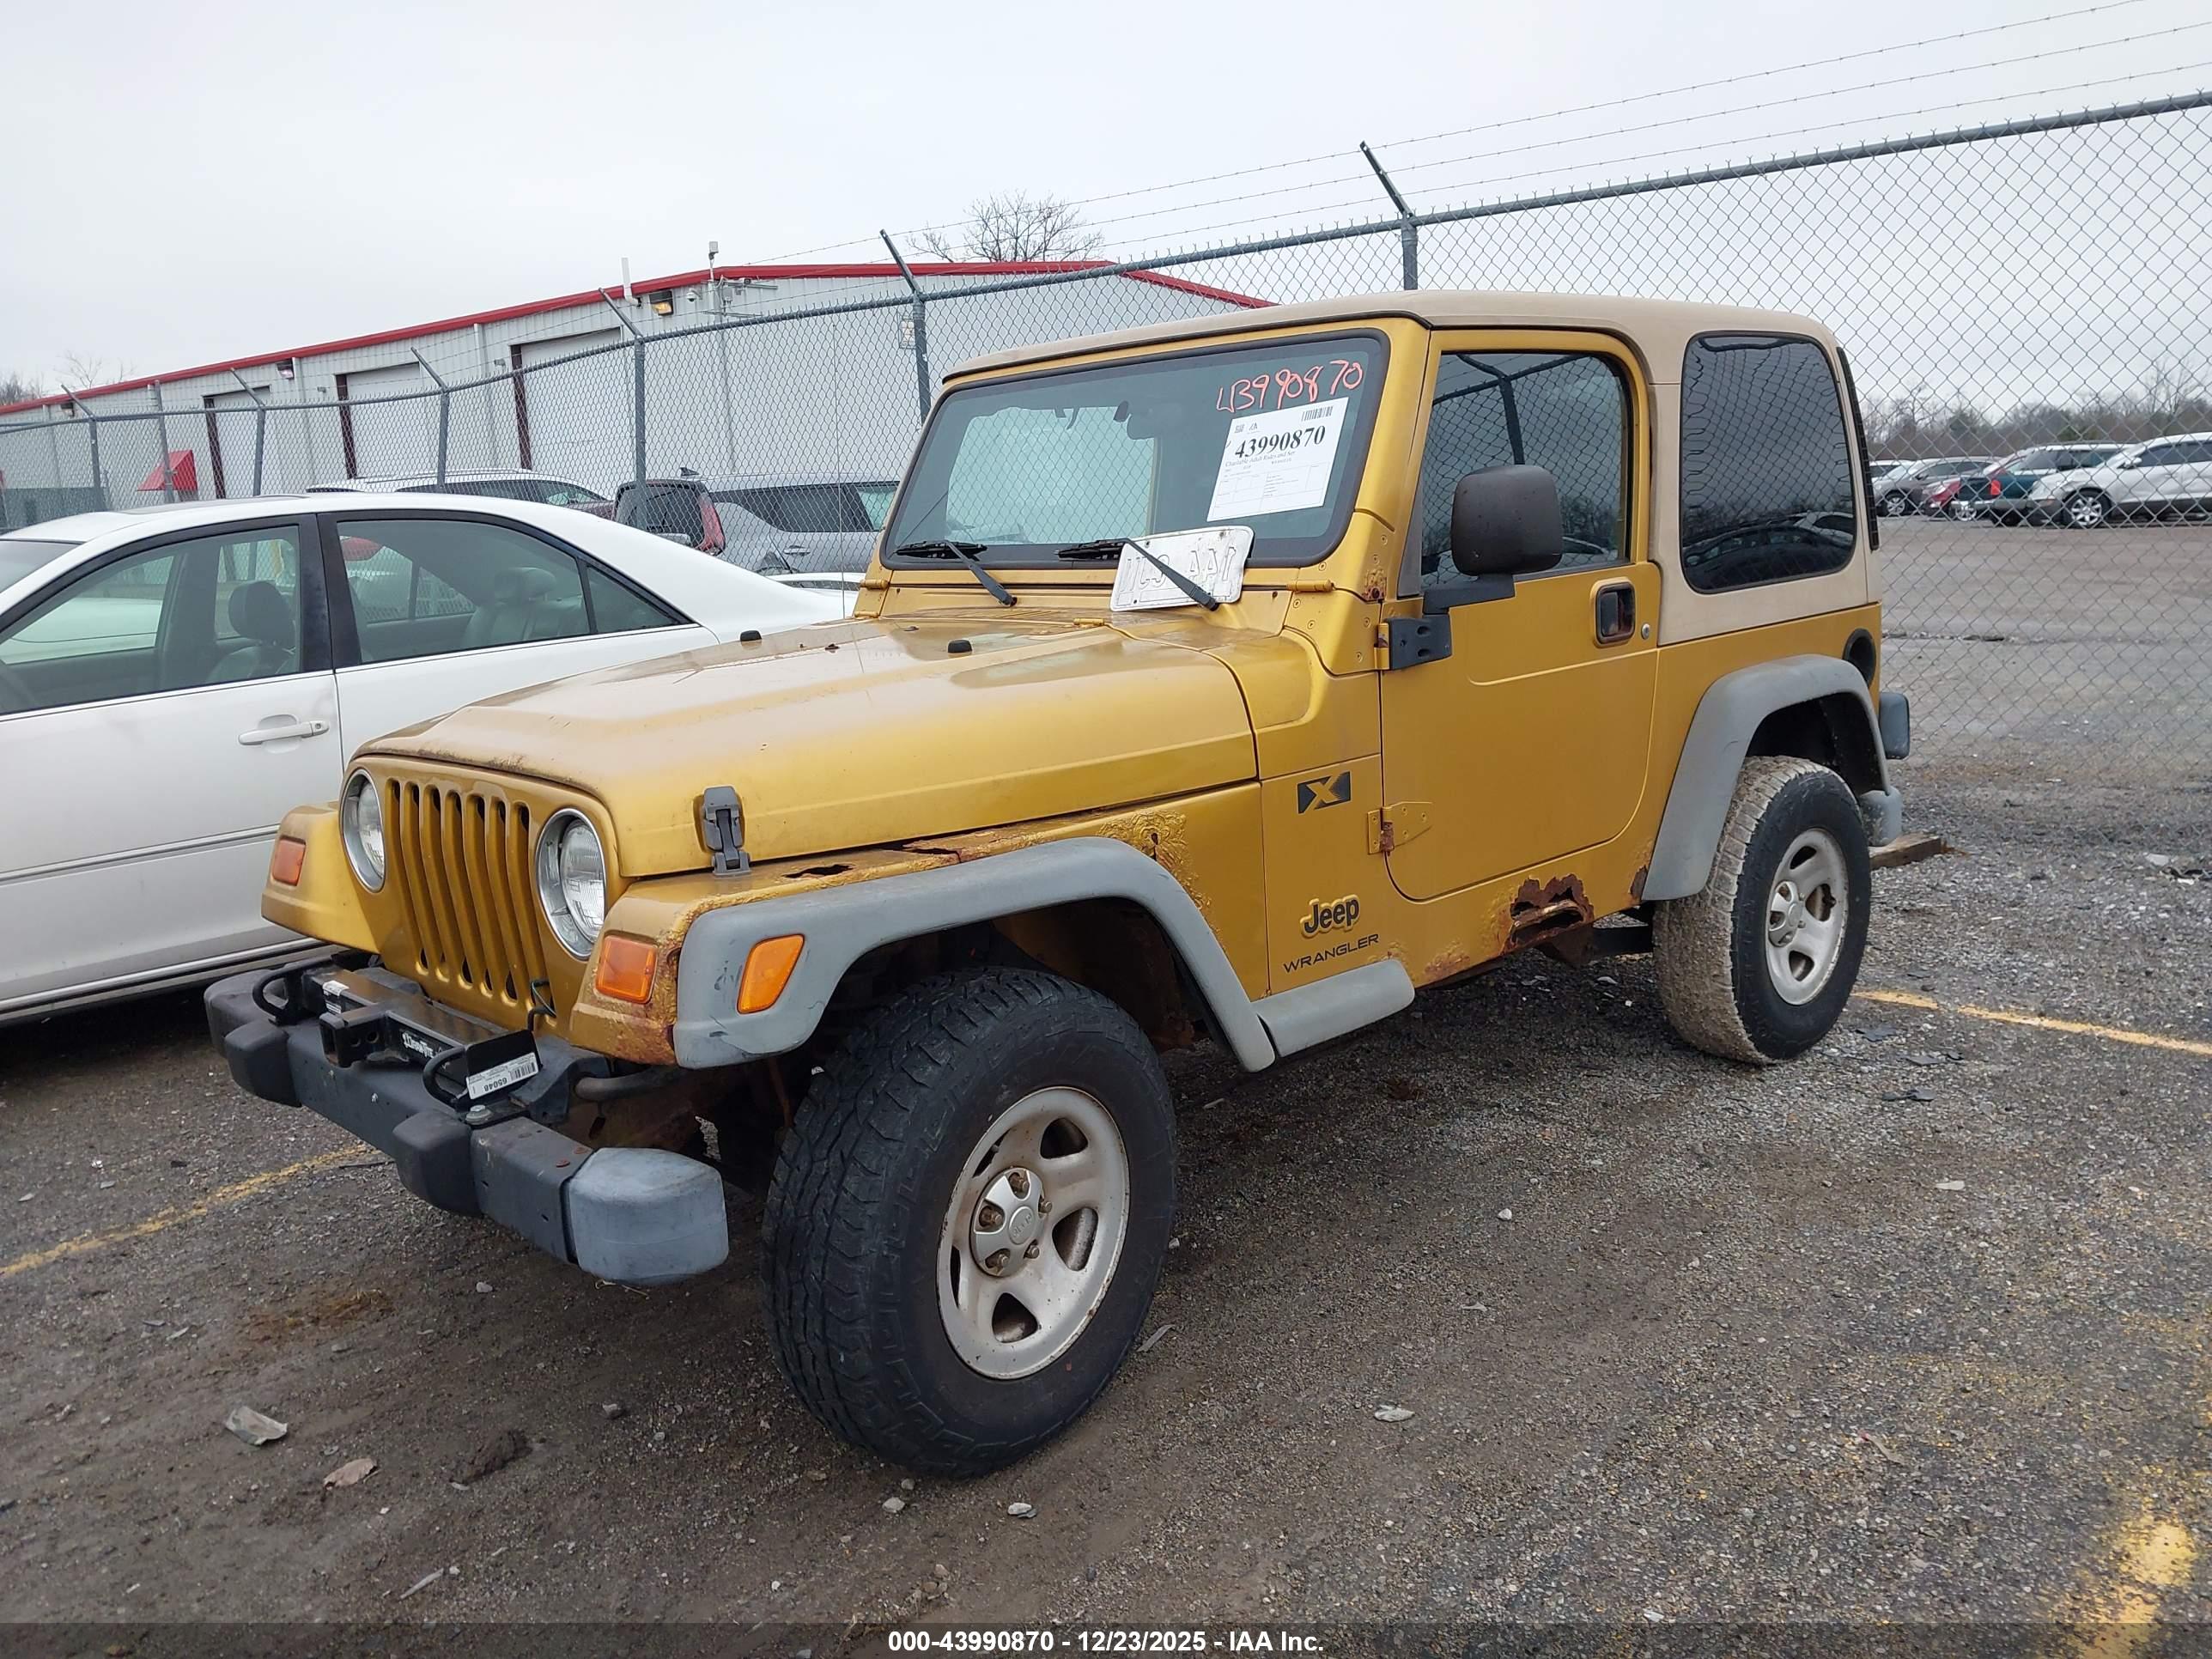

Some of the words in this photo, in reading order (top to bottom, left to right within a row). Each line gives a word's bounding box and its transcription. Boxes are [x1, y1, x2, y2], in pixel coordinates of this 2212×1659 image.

[1234, 425, 1326, 459] 43990870
[1303, 896, 1360, 935] Jeep
[1283, 933, 1379, 973] WRANGLER
[483, 1077, 507, 1091] 65048
